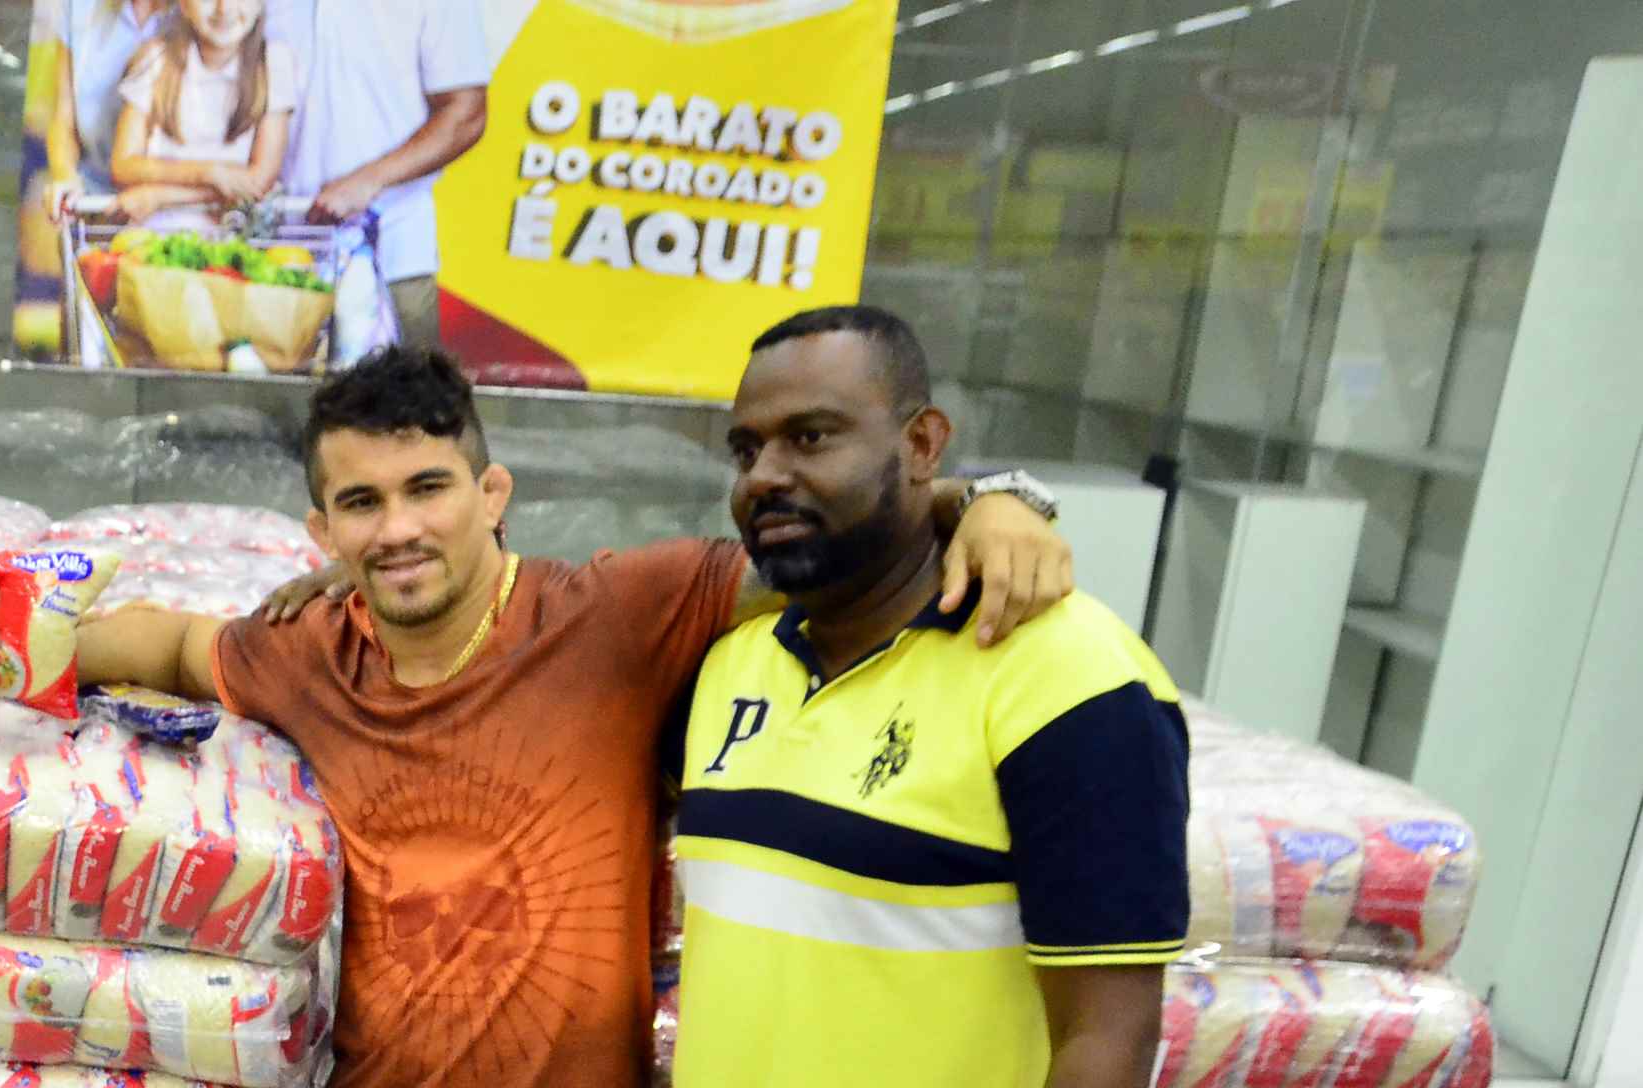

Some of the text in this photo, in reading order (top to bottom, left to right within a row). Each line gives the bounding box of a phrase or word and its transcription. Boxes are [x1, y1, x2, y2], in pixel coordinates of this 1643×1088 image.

[527, 81, 842, 161] O BARATO
[520, 143, 827, 209] DO COROADO
[508, 180, 821, 291] É AQUI!
[704, 697, 770, 774] P
